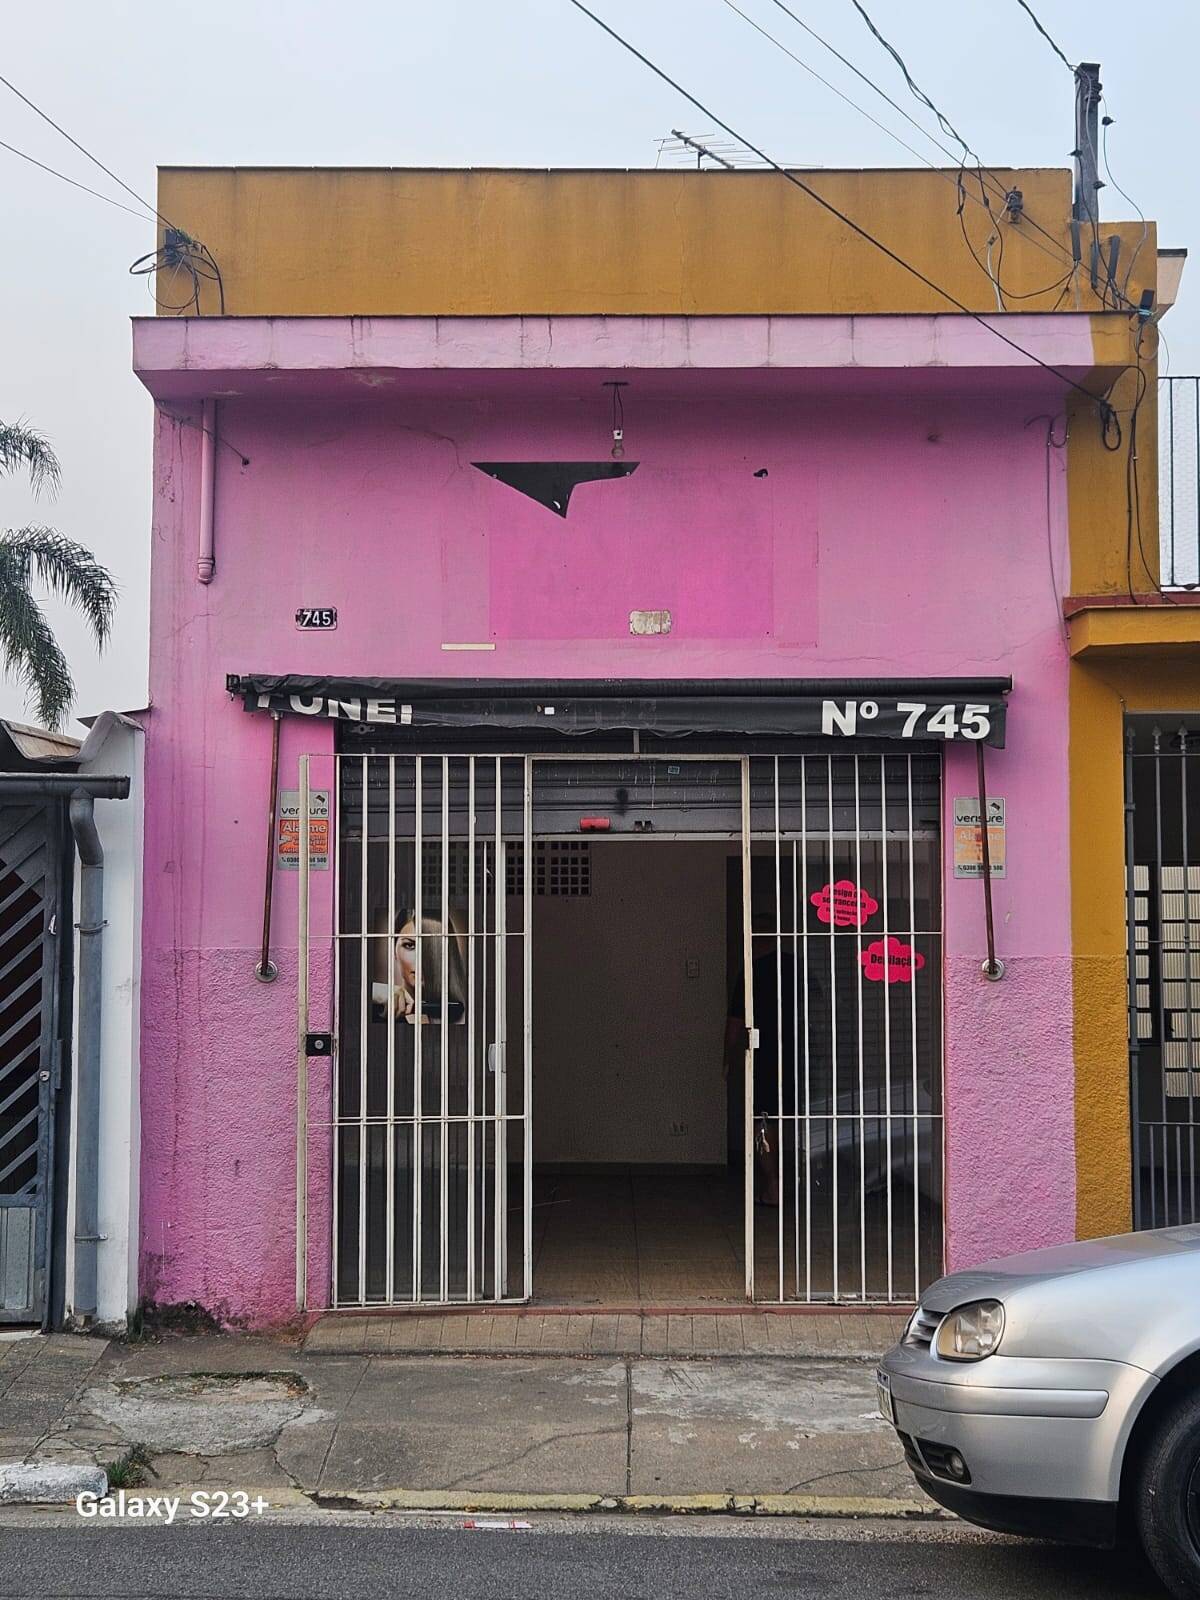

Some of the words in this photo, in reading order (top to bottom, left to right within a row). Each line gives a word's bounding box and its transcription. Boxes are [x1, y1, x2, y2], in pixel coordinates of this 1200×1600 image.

[302, 611, 331, 626] 745
[896, 702, 990, 740] 745
[281, 806, 328, 815] verure
[283, 821, 327, 833] Alame
